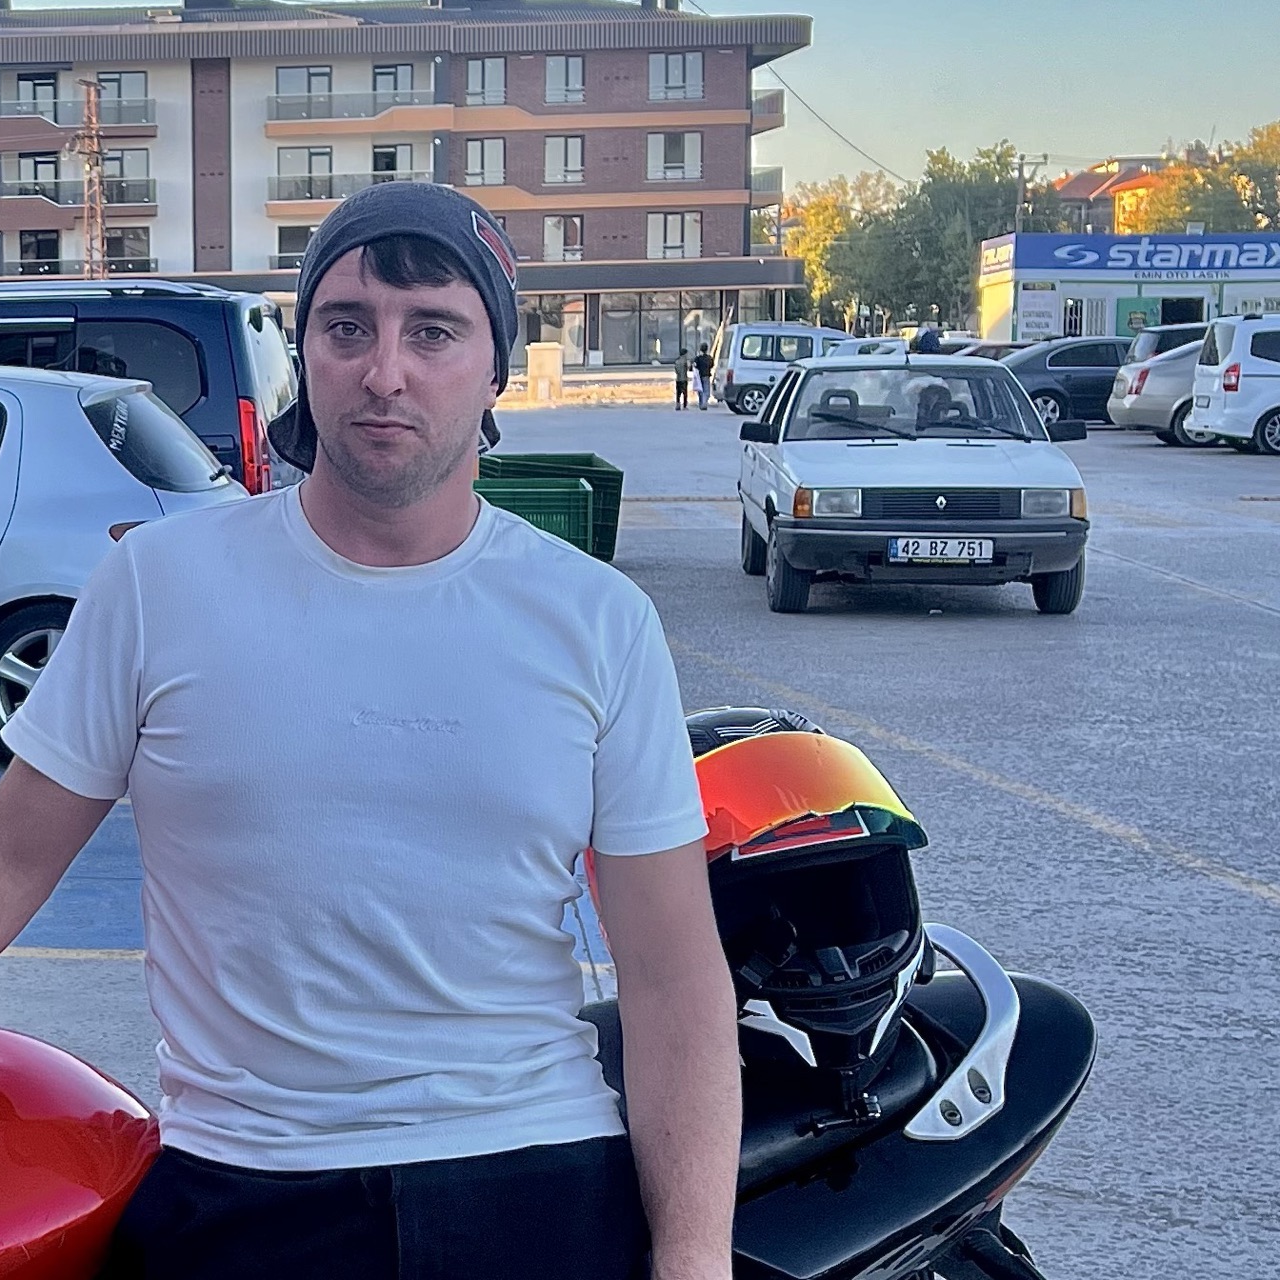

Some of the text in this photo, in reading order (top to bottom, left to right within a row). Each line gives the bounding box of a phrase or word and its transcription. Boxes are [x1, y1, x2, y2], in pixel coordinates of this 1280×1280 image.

[1166, 270, 1189, 280] OTO
[902, 540, 983, 557] 42 BZ 751
